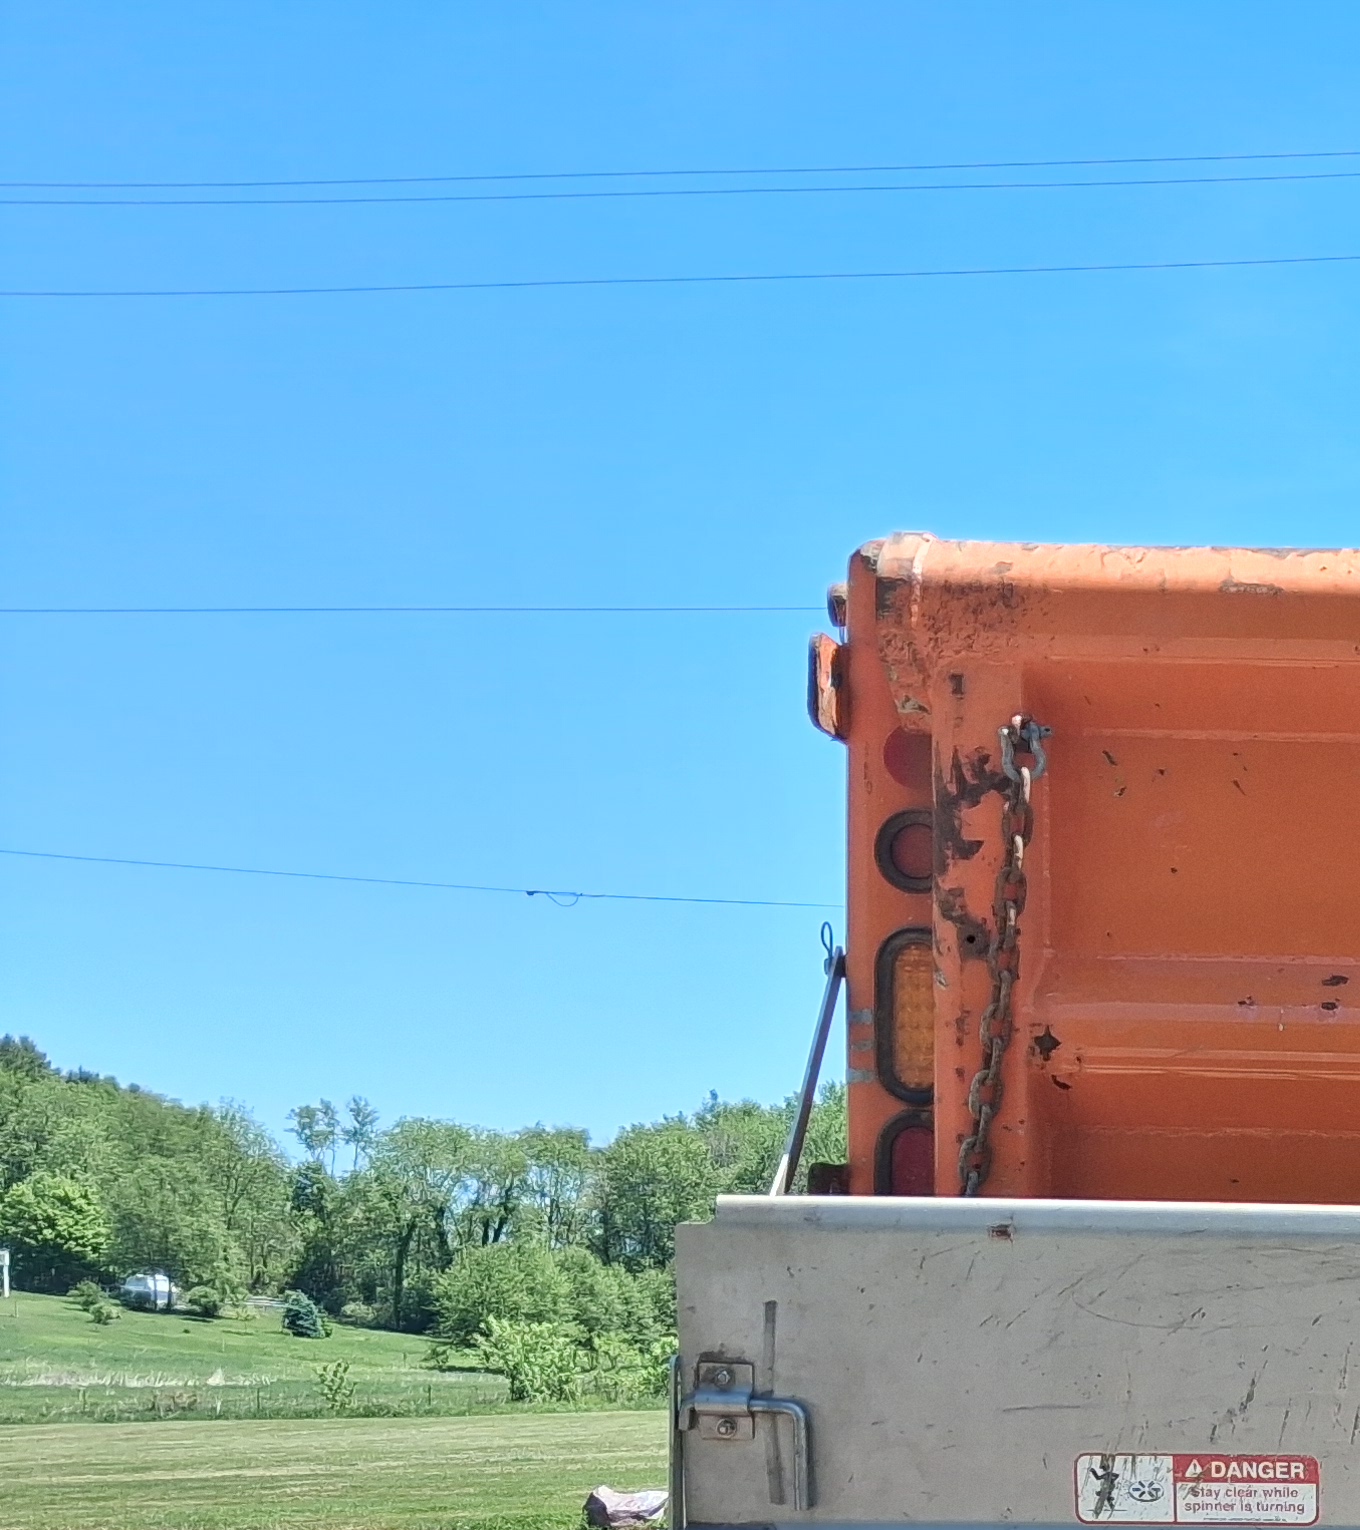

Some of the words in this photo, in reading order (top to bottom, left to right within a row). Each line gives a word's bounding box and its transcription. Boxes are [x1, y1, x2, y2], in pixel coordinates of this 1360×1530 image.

[1211, 1461, 1305, 1479] DANGER
[1189, 1487, 1221, 1500] Stay
[1225, 1487, 1258, 1498] clear
[1262, 1487, 1299, 1498] while
[1184, 1501, 1237, 1514] spinner
[1240, 1501, 1252, 1512] is
[1256, 1501, 1305, 1515] turning
